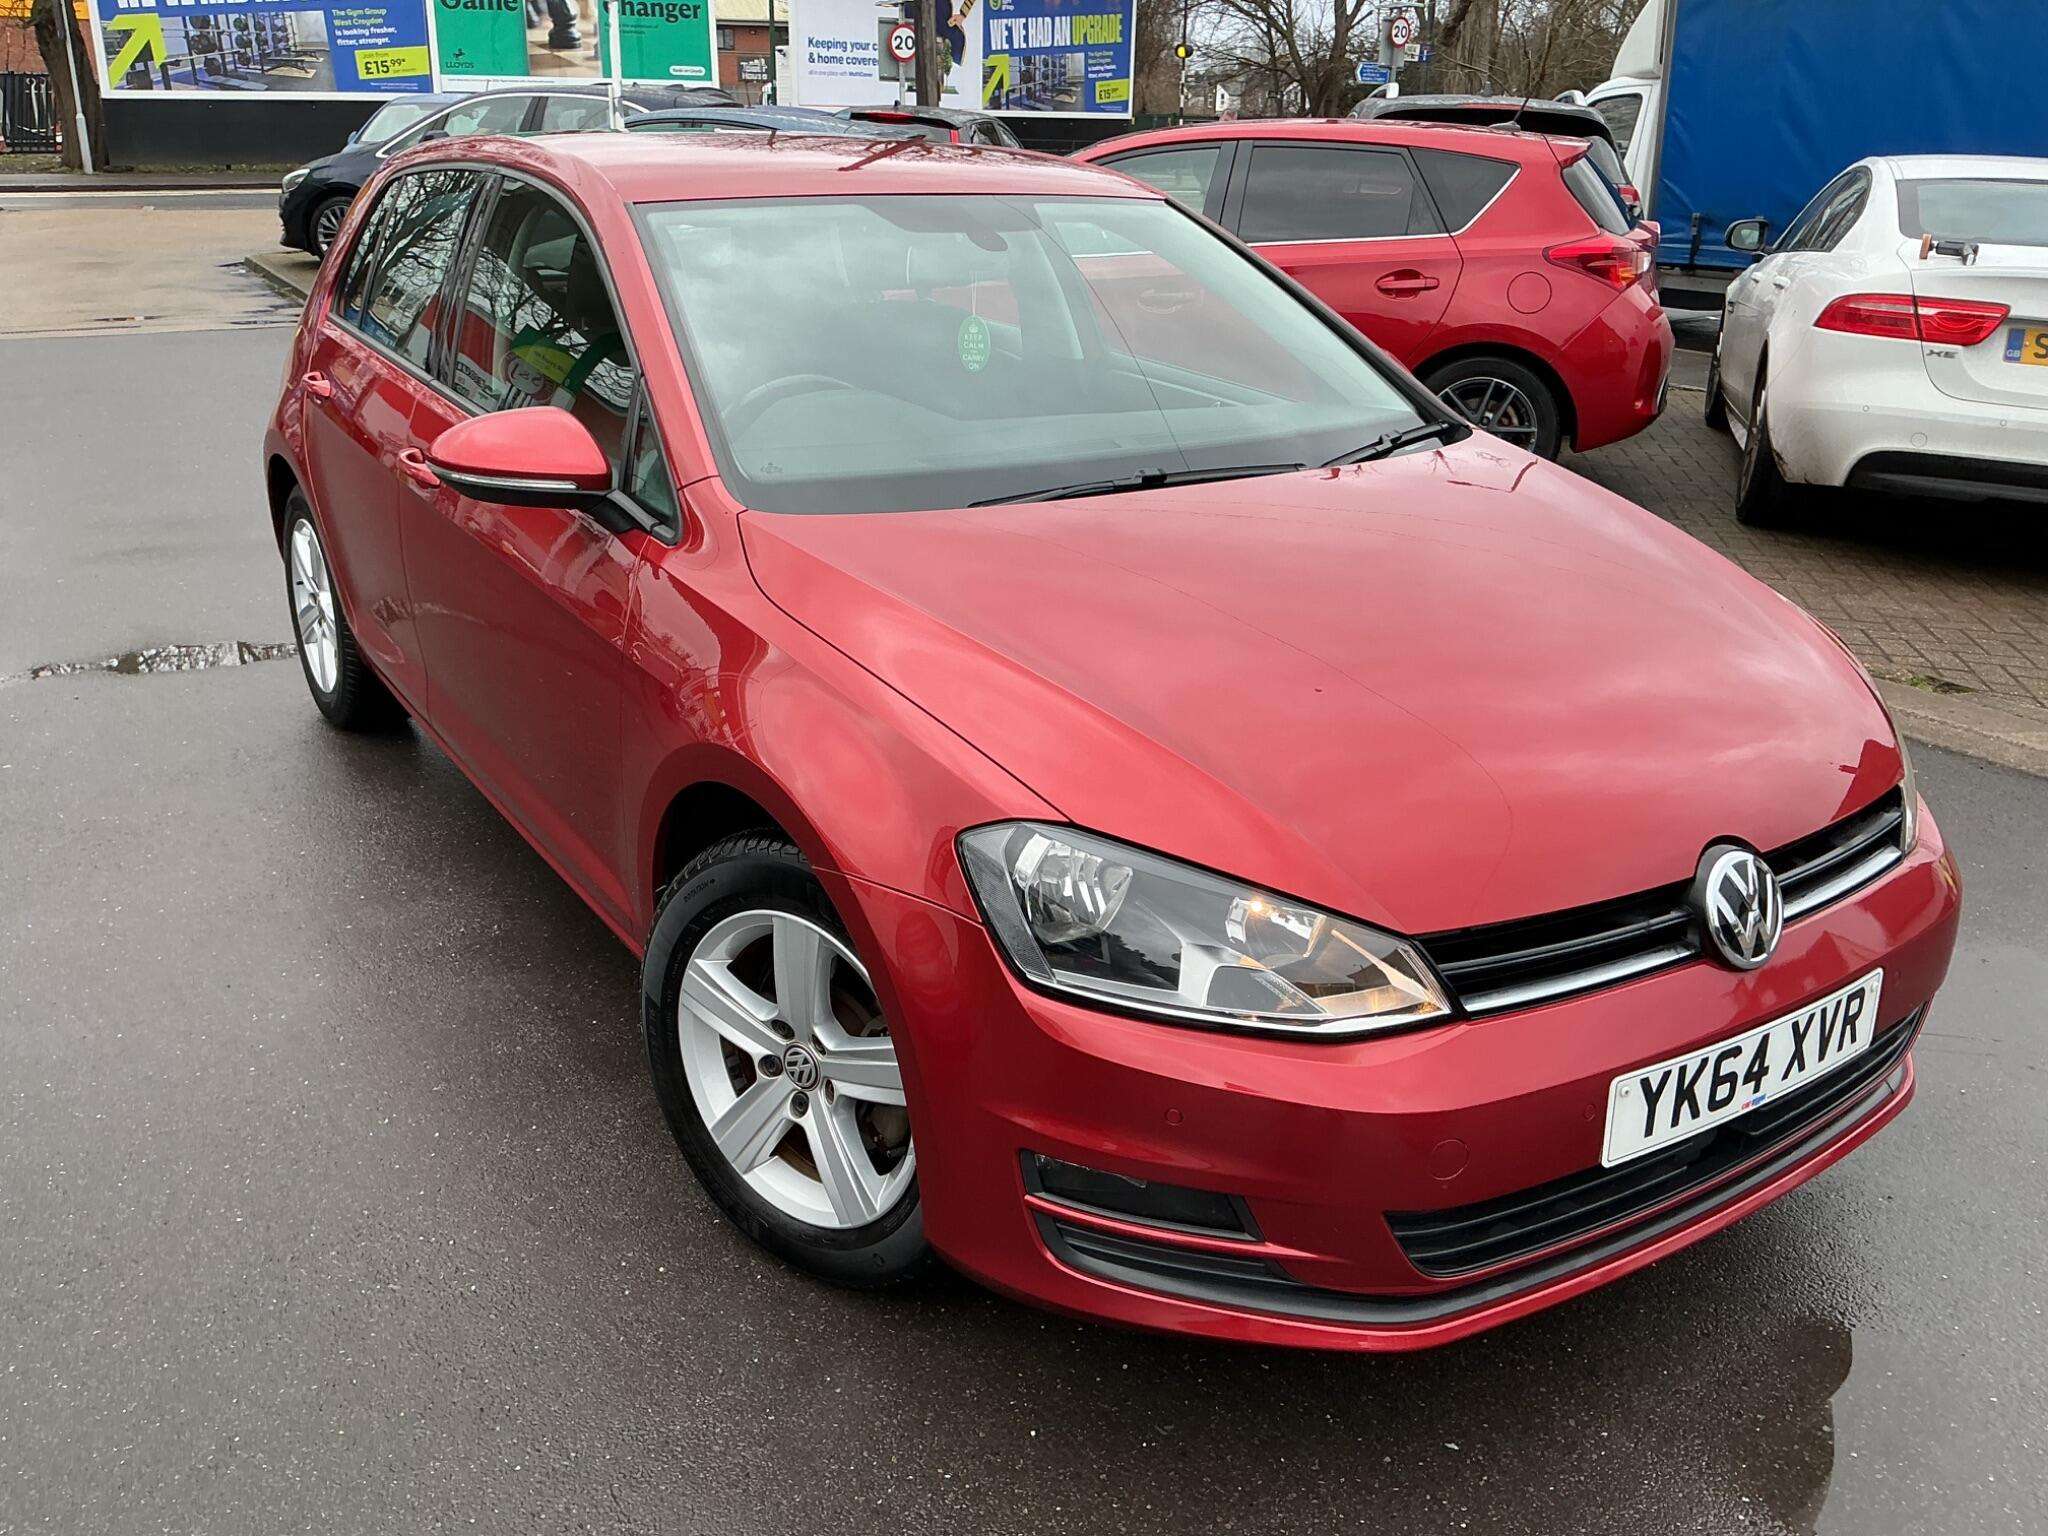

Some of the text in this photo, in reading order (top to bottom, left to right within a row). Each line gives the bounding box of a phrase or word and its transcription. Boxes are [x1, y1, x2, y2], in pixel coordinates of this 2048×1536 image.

[364, 8, 387, 16] Group
[343, 28, 370, 36] looking
[989, 13, 1123, 50] WE'VE HAD AN UPGRADE
[1394, 25, 1408, 38] 20
[807, 36, 848, 53] Keeping
[849, 41, 871, 53] your
[894, 35, 915, 51] 20
[808, 52, 879, 67] & home covere
[1926, 349, 1959, 359] XE
[2006, 348, 2021, 358] GB
[1639, 986, 1866, 1139] YK64 XVR
